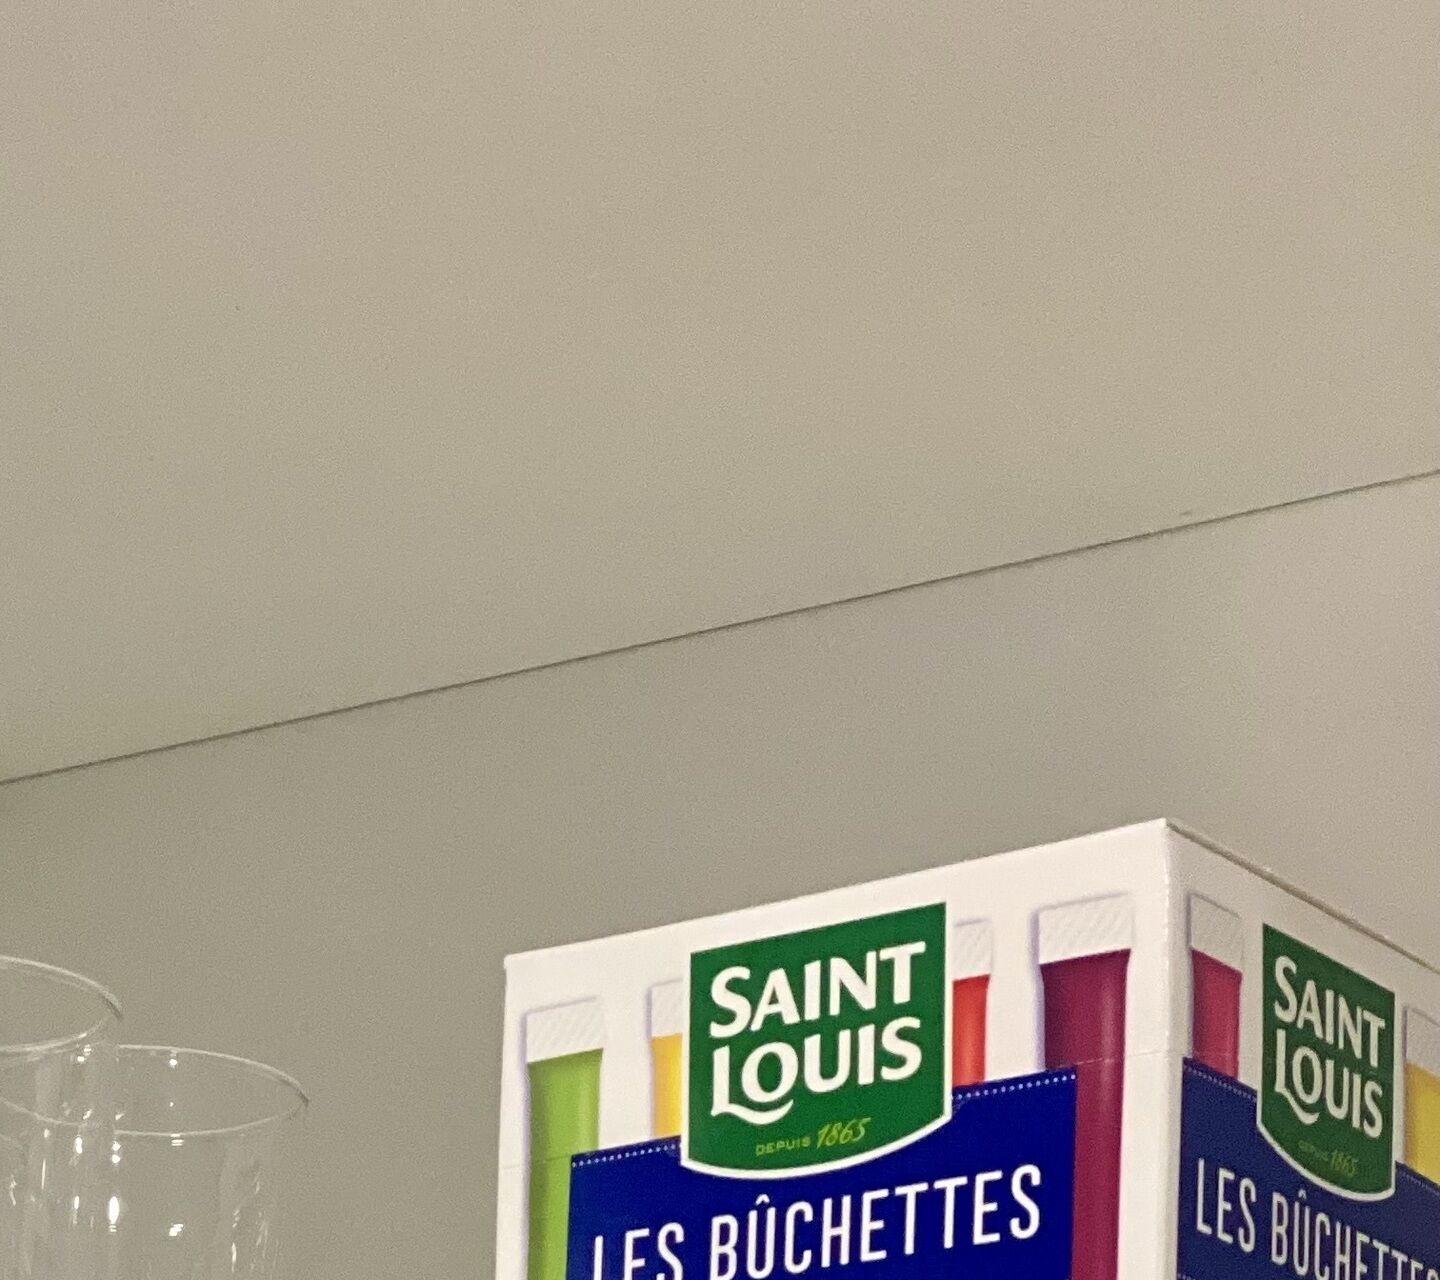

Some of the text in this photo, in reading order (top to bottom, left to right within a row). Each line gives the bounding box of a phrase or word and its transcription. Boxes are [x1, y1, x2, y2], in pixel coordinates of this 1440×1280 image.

[709, 940, 927, 1039] SAINT
[1273, 955, 1386, 1069] SAINT
[710, 1016, 923, 1126] LOUIS
[1274, 1028, 1384, 1139] LOUIS
[755, 1116, 872, 1157] DEPUIS 1865
[1196, 1158, 1257, 1253] LES
